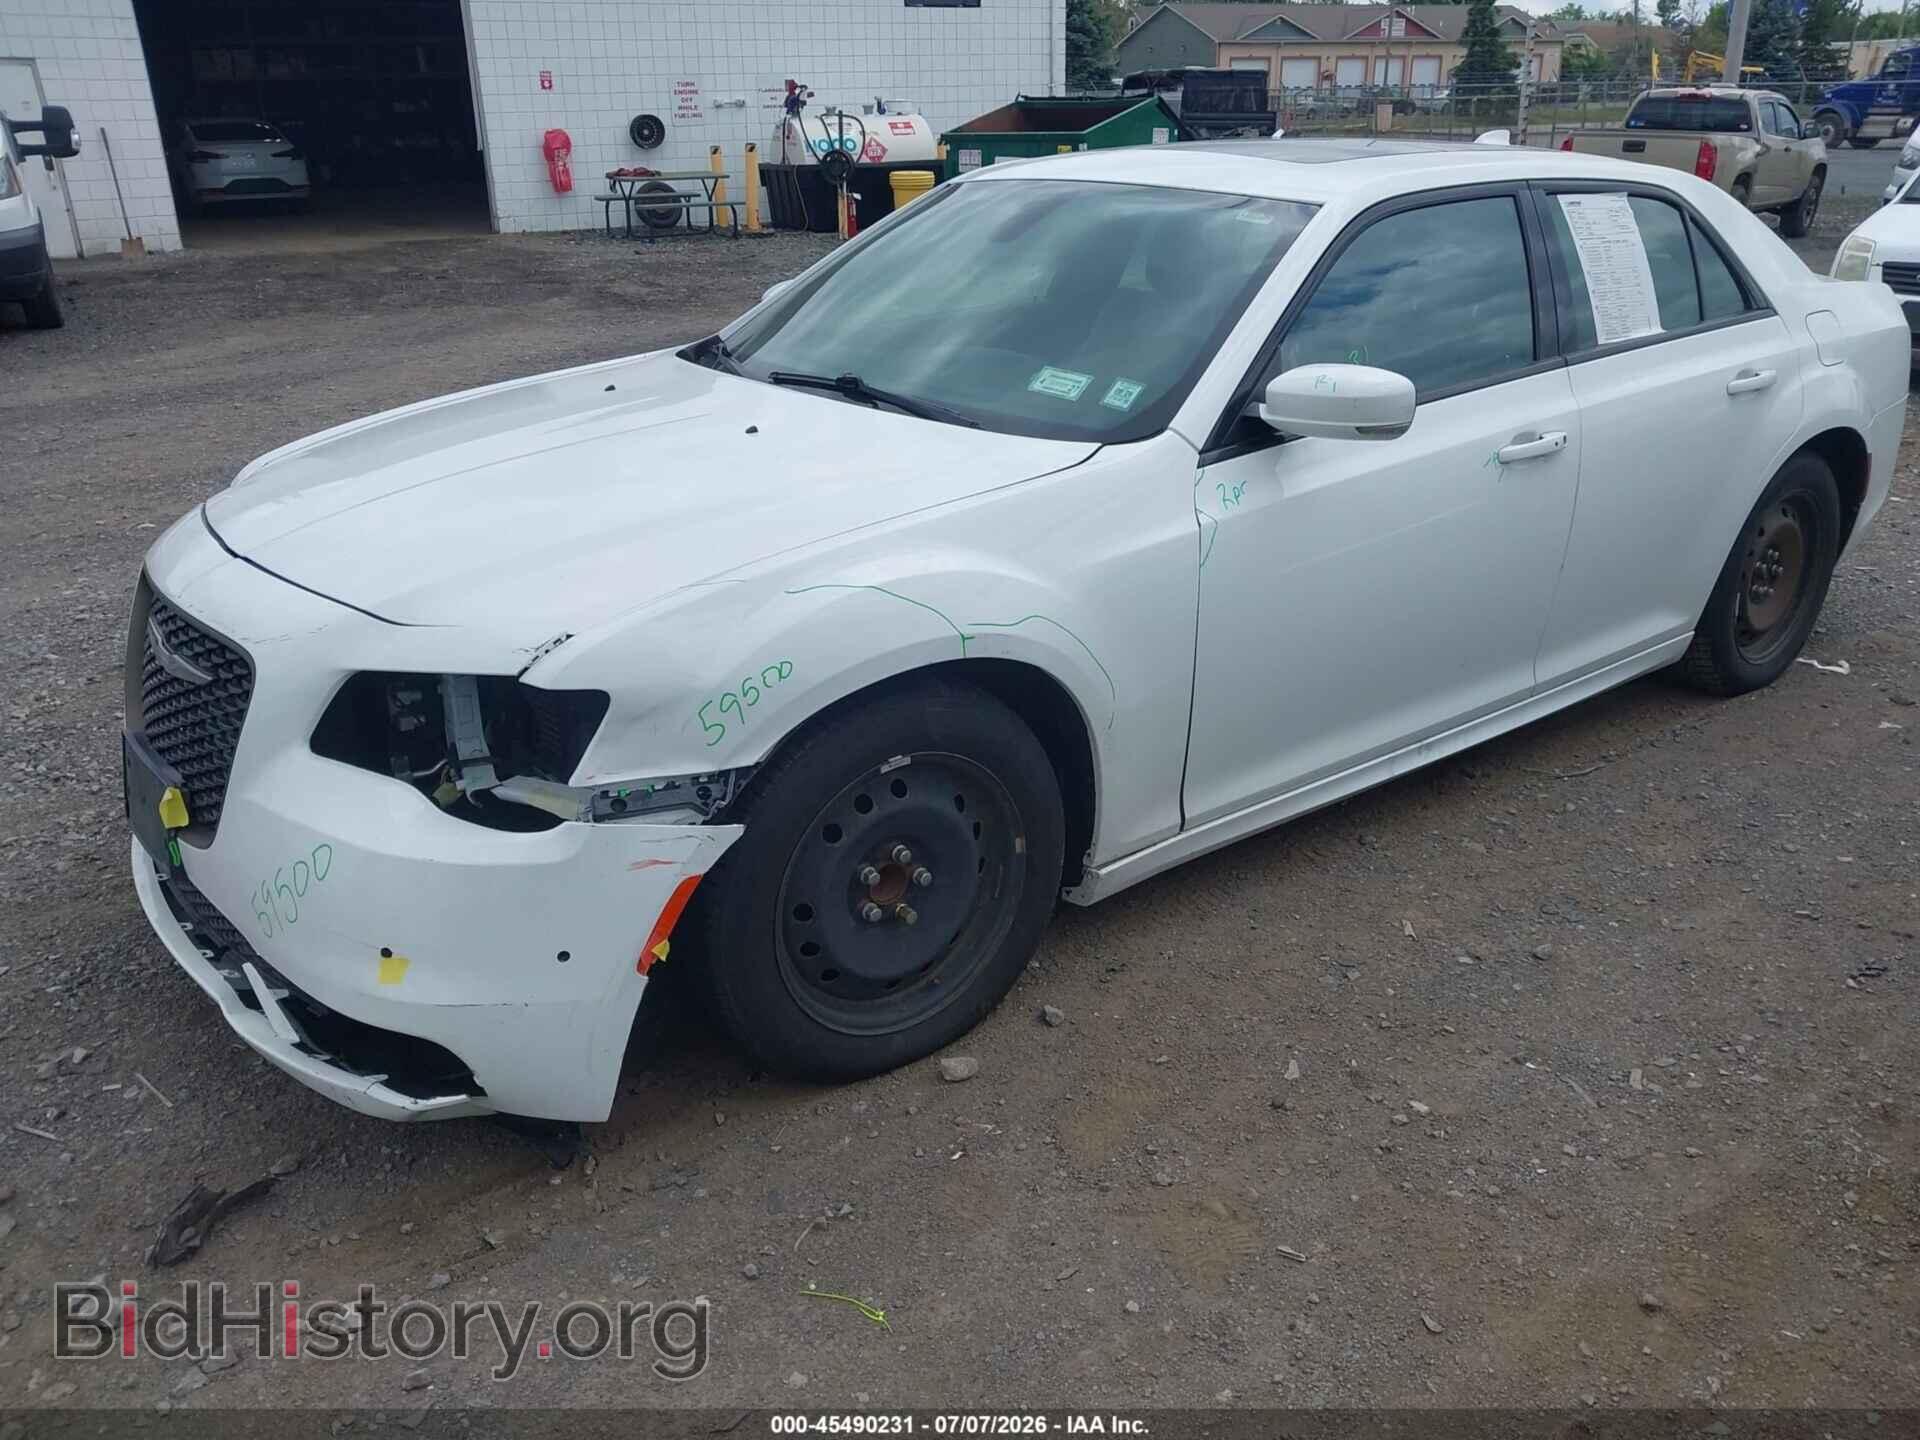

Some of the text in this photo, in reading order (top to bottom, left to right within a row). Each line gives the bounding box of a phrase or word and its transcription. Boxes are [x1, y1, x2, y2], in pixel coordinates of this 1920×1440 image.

[673, 112, 703, 120] FUELING
[698, 660, 793, 747] 59500
[250, 843, 333, 939] 59500
